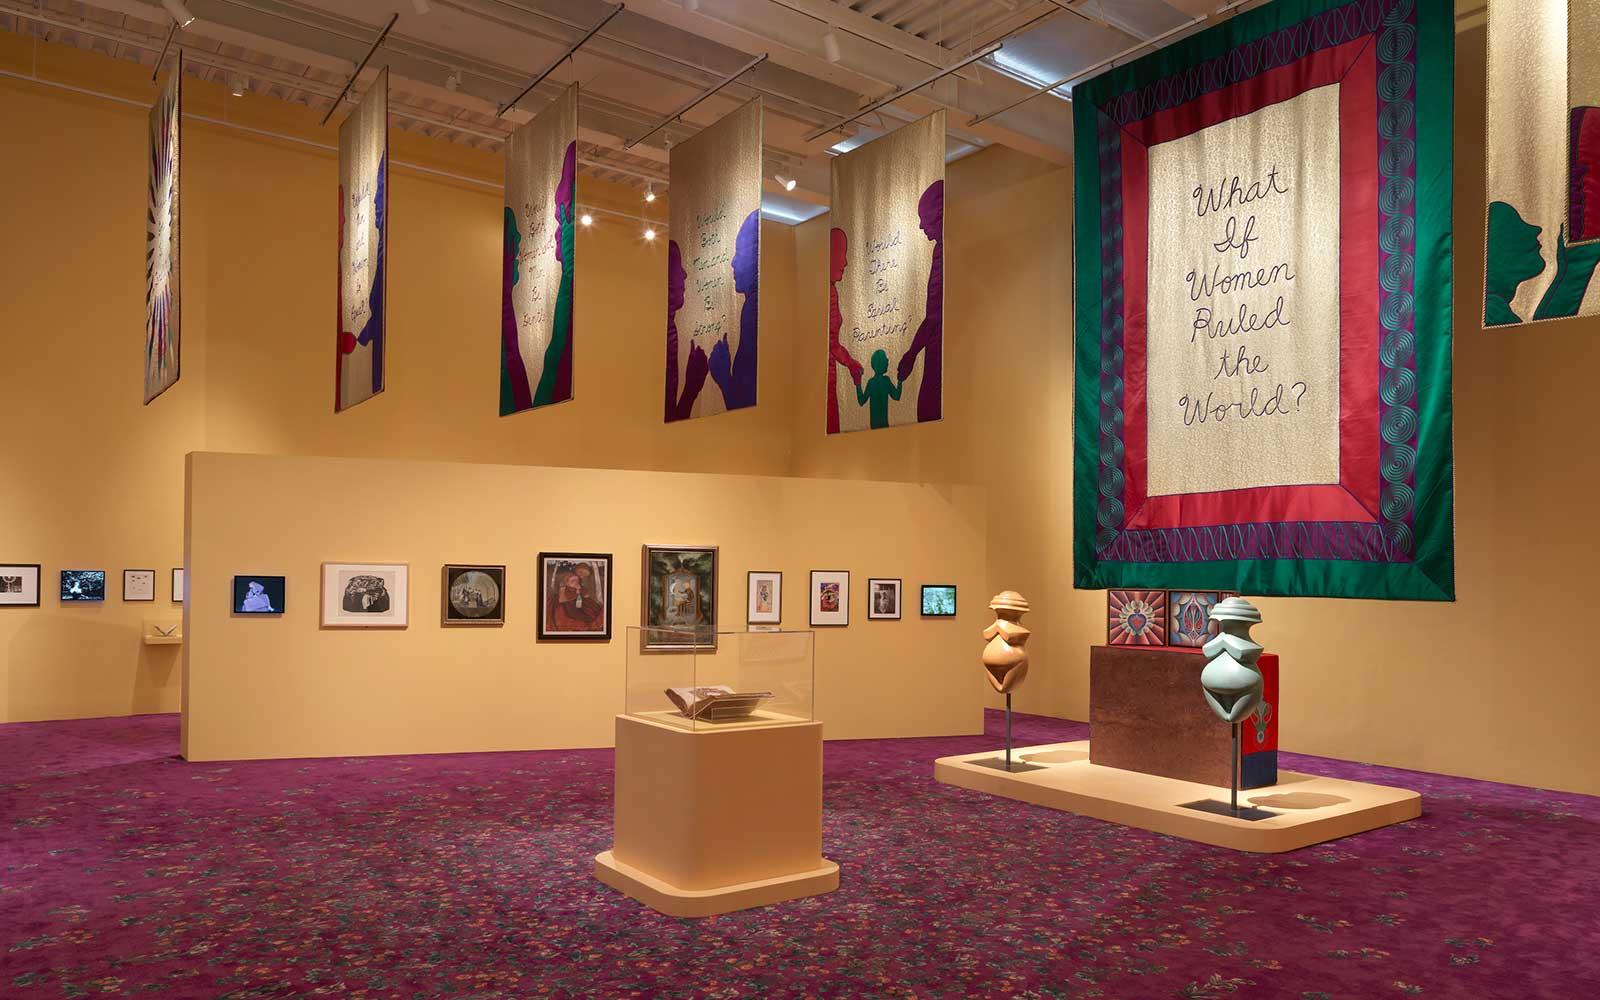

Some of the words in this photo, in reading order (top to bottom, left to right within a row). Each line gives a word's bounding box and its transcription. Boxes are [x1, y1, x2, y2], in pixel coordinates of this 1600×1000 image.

[1193, 166, 1289, 217] What
[866, 230, 902, 257] Would
[1214, 215, 1259, 259] If
[1186, 263, 1296, 301] Women
[867, 297, 900, 321] Equal
[1191, 296, 1291, 342] Ruled
[1214, 346, 1269, 380] the
[1179, 381, 1307, 426] World?
